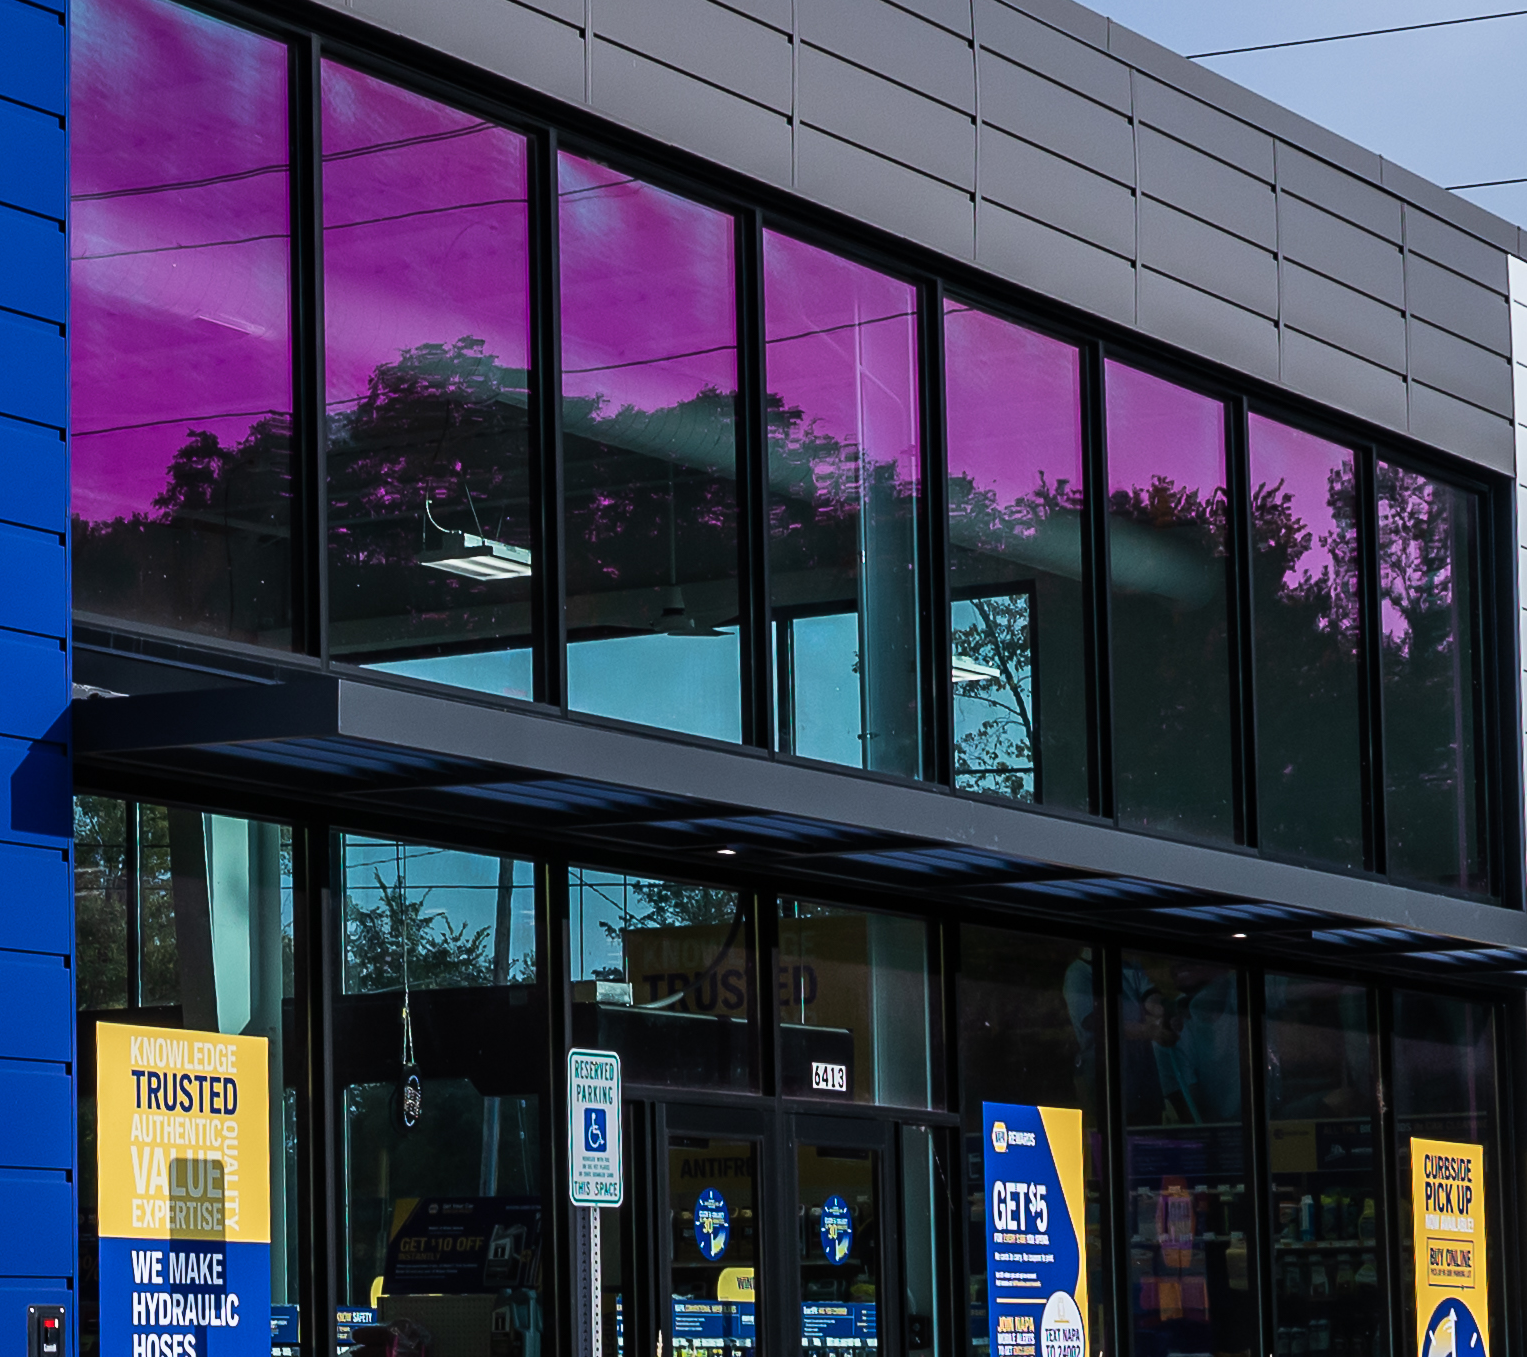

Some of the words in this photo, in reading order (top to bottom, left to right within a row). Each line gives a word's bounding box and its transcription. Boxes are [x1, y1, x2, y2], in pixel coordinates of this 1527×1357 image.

[130, 1035, 238, 1074] KNOWLEDGE
[574, 1060, 614, 1081] RESERVED
[814, 1065, 844, 1088] 6413
[131, 1069, 238, 1116] TRUSTED
[576, 1083, 613, 1105] PARKING
[131, 1113, 222, 1147] AUTHENTIC
[1008, 1130, 1035, 1146] REWARDS
[130, 1145, 223, 1199] VALUE
[221, 1120, 240, 1231] QUALITY
[1424, 1153, 1472, 1183] CURBSIDE
[574, 1180, 590, 1195] THIS
[594, 1181, 618, 1197] SPACE
[1424, 1181, 1453, 1214] PICK
[1456, 1185, 1473, 1216] UP
[131, 1198, 223, 1231] EXPERTISE
[992, 1180, 1028, 1231] GET
[1029, 1182, 1048, 1233] $5
[400, 1238, 428, 1252] GET
[456, 1237, 485, 1251] OFF
[1430, 1247, 1445, 1267] BUY
[1445, 1248, 1472, 1268] ONLINE
[131, 1250, 163, 1284] WE
[169, 1252, 223, 1285] MAKE
[132, 1292, 240, 1327] HYDRAULIC
[997, 1316, 1014, 1332] JOIN
[1015, 1316, 1035, 1332] NAPA
[1045, 1328, 1061, 1342] TEXT
[1062, 1328, 1081, 1342] NAPA
